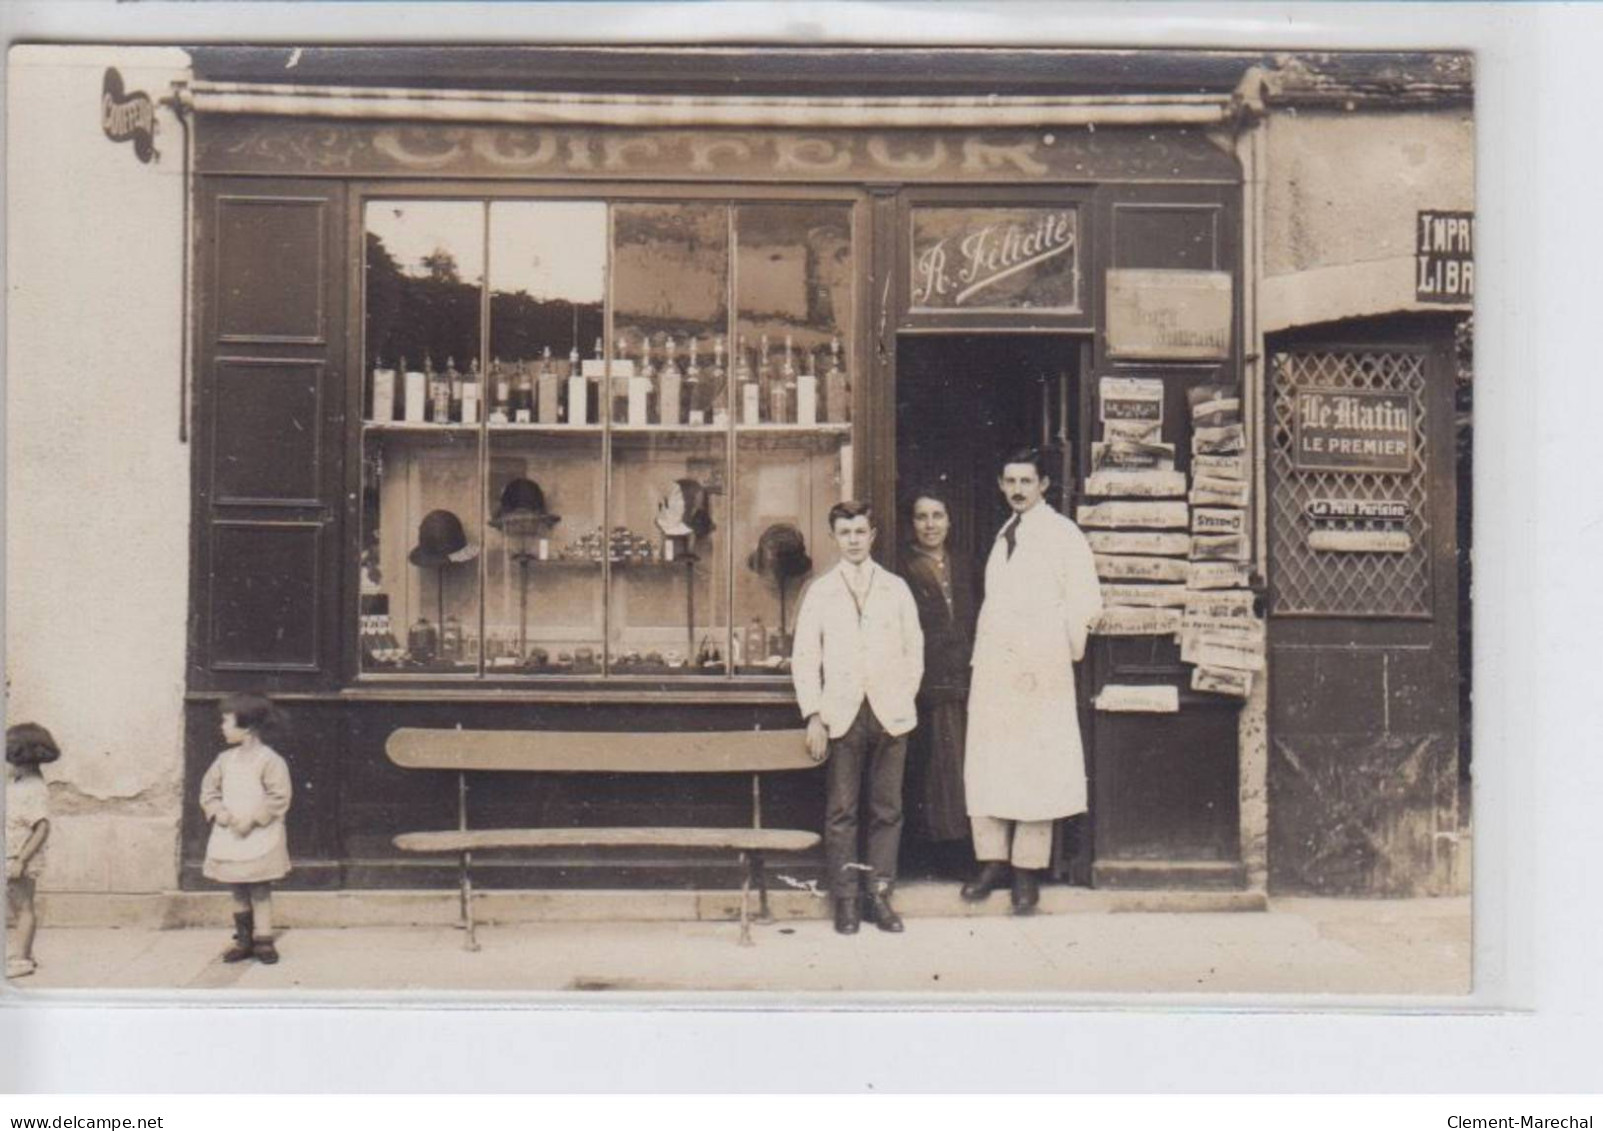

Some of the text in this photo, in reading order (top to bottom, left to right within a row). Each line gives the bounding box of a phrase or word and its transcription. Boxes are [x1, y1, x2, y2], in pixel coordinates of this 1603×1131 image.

[1301, 394, 1407, 431] Le Matin
[1303, 437, 1407, 456] LE PREMIER
